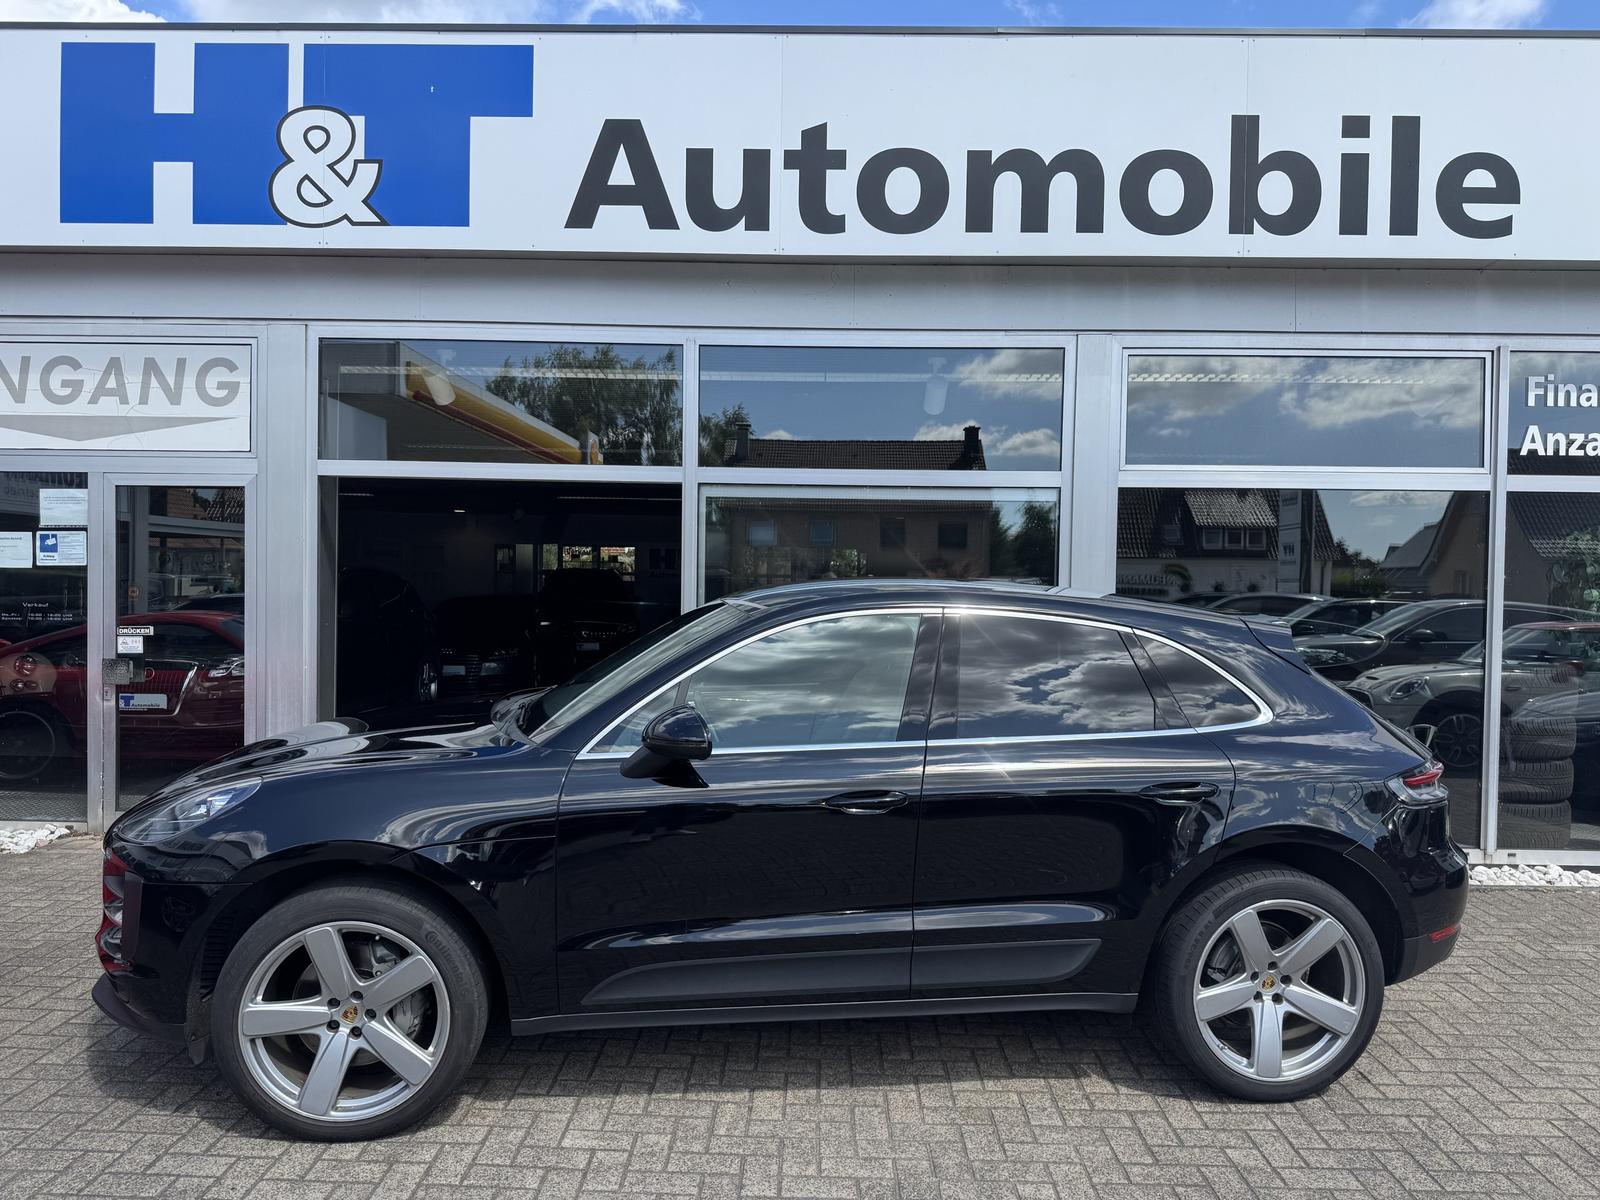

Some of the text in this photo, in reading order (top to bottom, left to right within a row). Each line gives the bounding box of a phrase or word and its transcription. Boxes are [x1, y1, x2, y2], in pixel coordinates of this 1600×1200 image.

[60, 42, 1521, 240] H&T Automobile
[1526, 374, 1599, 408] Fina
[1520, 425, 1600, 457] Anza
